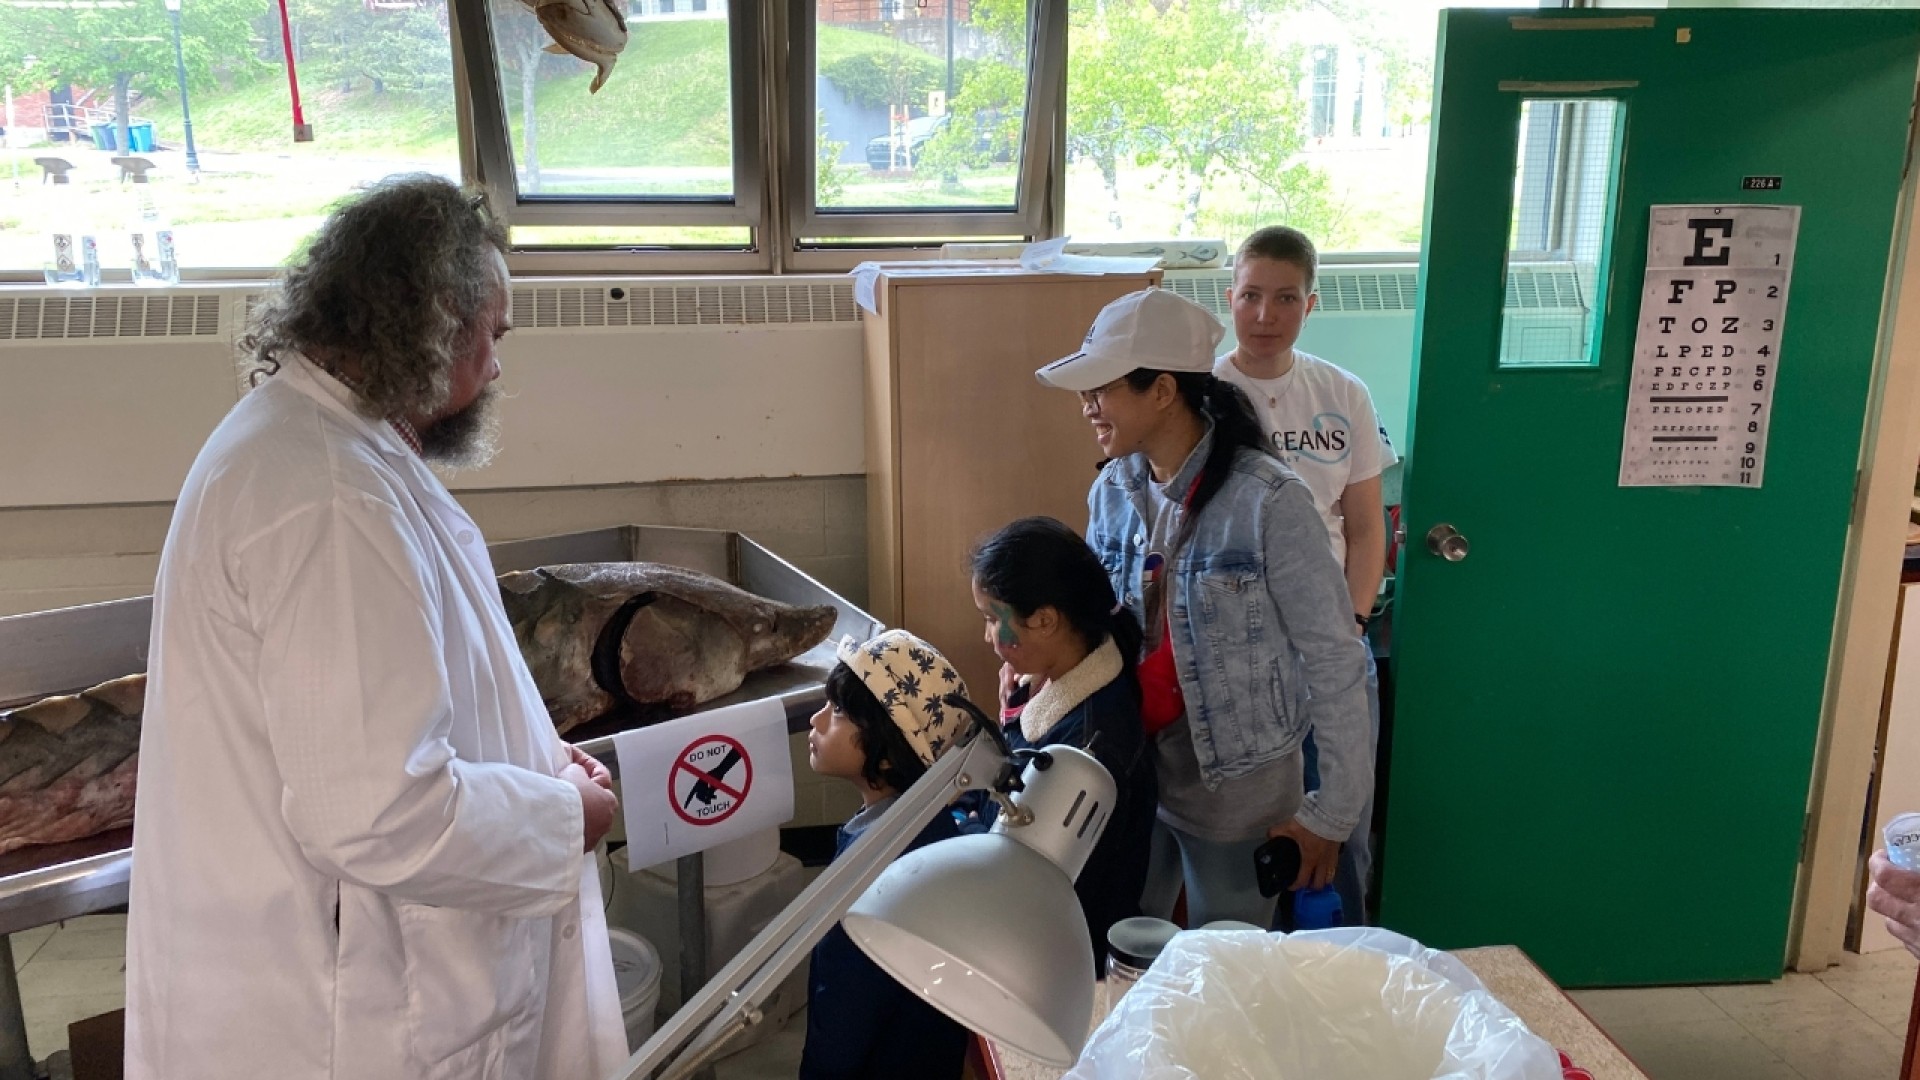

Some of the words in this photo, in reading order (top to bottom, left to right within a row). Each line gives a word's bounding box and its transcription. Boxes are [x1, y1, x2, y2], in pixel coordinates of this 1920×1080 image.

[1682, 218, 1735, 267] E
[1774, 253, 1781, 266] 1
[1667, 279, 1695, 304] F
[1712, 279, 1738, 304] P
[1766, 285, 1779, 299] 2
[1658, 316, 1677, 334] T
[1691, 317, 1708, 334] O
[1721, 317, 1740, 334] Z
[1762, 319, 1774, 332] 3
[1757, 344, 1771, 358] 4
[1755, 364, 1767, 378] 5
[1752, 379, 1764, 392] 6
[1750, 402, 1762, 415] 7
[1747, 420, 1758, 433] 8
[1271, 429, 1345, 451] CEANS
[1745, 441, 1756, 454] 9
[1740, 456, 1756, 469] 10
[1739, 471, 1751, 484] 11
[689, 751, 705, 763] DO
[706, 744, 727, 757] NOT
[696, 801, 730, 818] TOUCH
